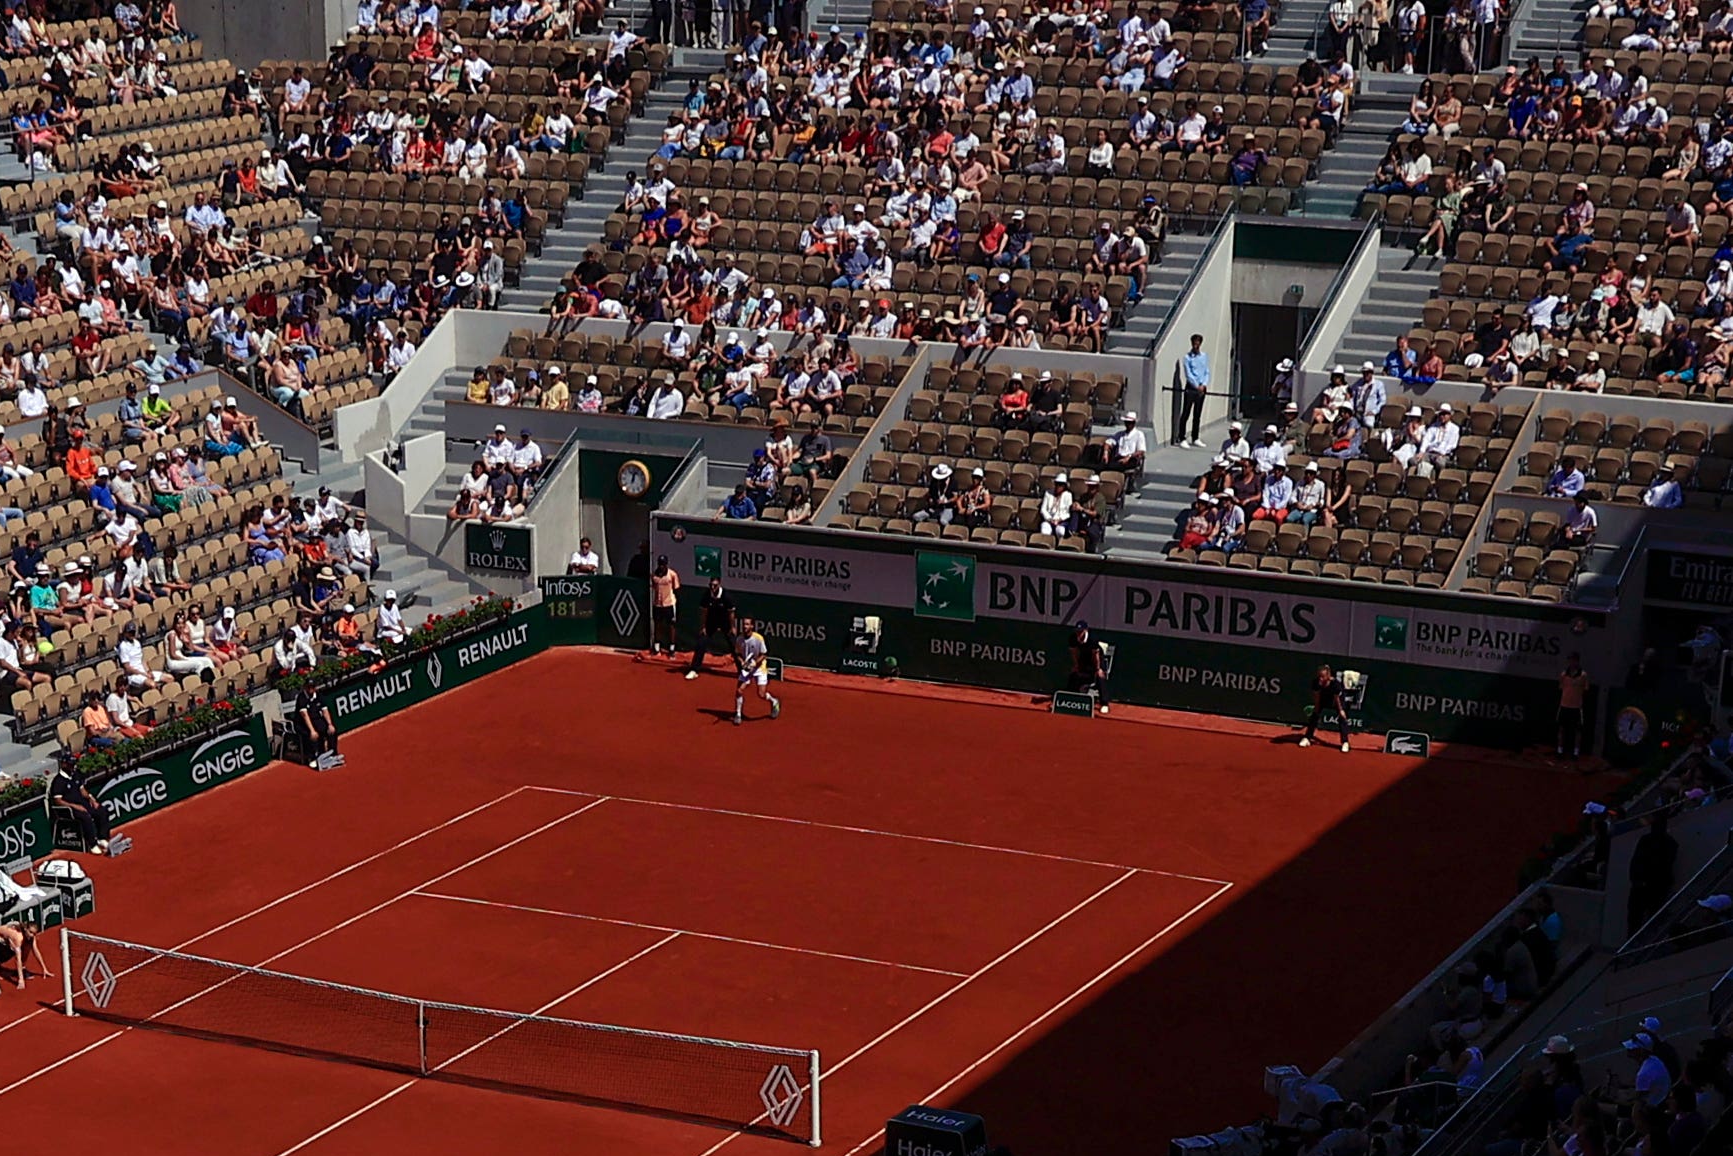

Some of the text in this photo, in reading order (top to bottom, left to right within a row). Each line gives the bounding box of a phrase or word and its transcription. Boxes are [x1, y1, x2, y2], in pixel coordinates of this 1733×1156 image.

[469, 552, 528, 571] ROLEX
[728, 550, 850, 579] BNP PARIBAS
[545, 579, 591, 598] Infosys
[548, 601, 577, 617] 181
[989, 572, 1317, 644] BNP PARIBAS
[755, 620, 826, 641] PARIBAS
[1417, 622, 1561, 656] BNP PARIBAS
[458, 624, 529, 668] RENAULT
[931, 639, 1046, 667] BNP PARIBAS
[1417, 643, 1432, 653] The
[1435, 646, 1458, 655] bank
[1460, 649, 1473, 658] for
[843, 658, 878, 670] LACOSTE
[1159, 665, 1281, 694] BNP PARIBAS
[335, 669, 412, 717] RENAULT
[1056, 700, 1091, 712] LACOSTE
[1396, 692, 1525, 721] BNP PARIBAS
[1323, 712, 1363, 727] LACSTE
[907, 1110, 965, 1127] Haier
